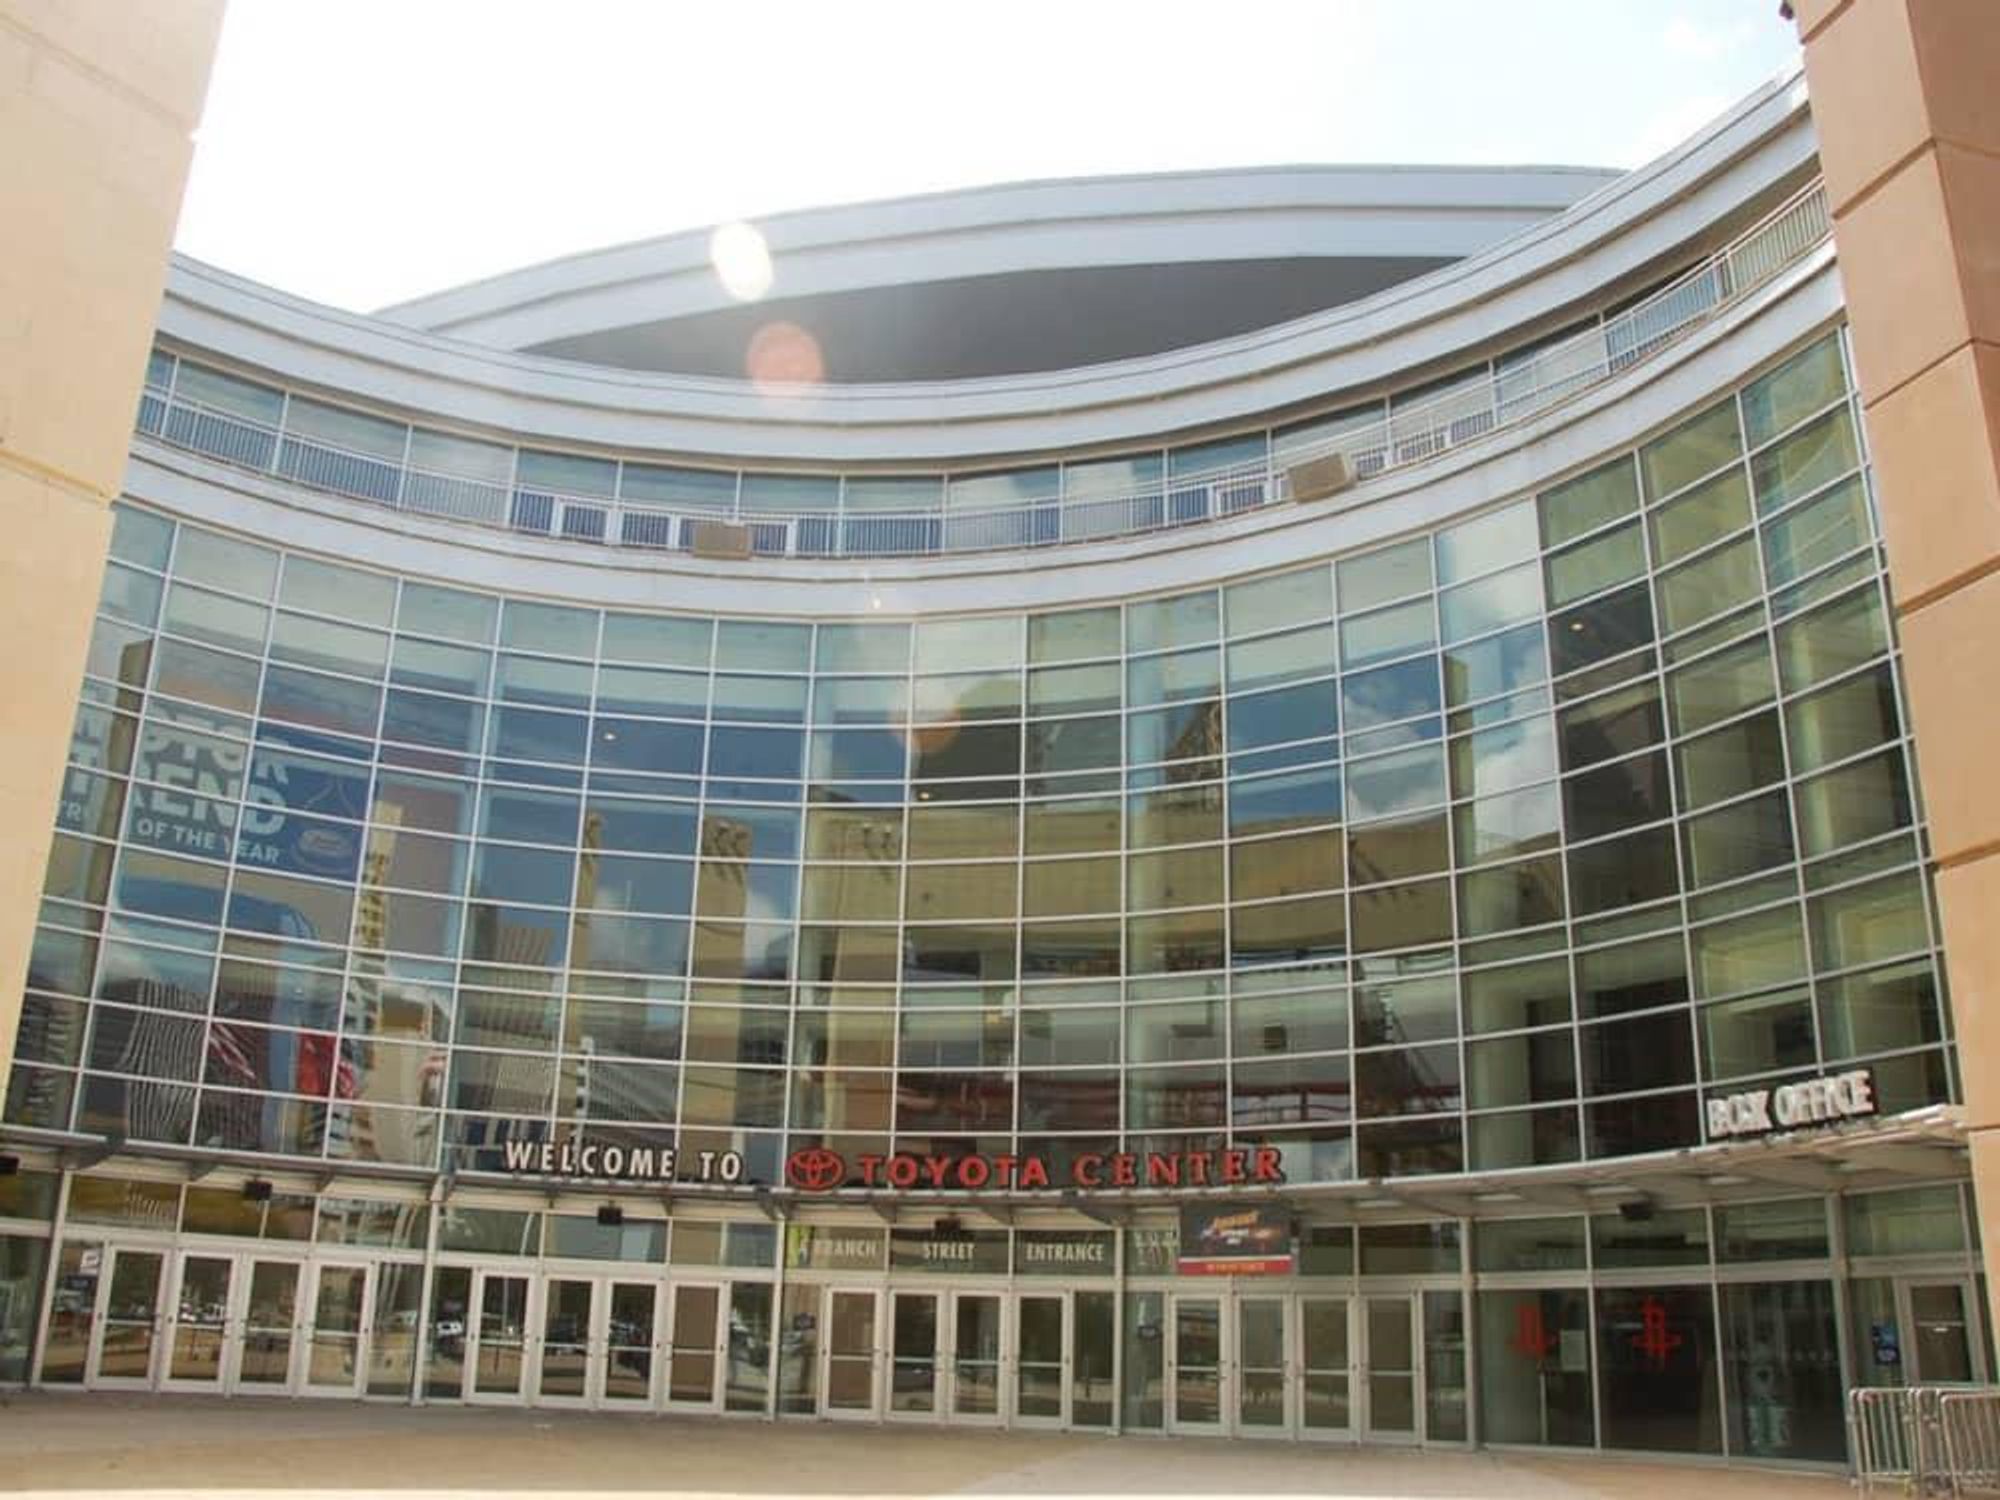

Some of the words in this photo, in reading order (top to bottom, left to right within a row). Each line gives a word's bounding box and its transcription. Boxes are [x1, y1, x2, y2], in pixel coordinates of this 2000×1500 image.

[136, 817, 168, 840] OF
[172, 824, 217, 851] THE
[223, 833, 281, 864] YEAR
[1706, 1090, 1773, 1137] BOX
[1775, 1069, 1874, 1126] OFFICE
[506, 1141, 674, 1178] WELCOME
[700, 1151, 741, 1181] TO
[857, 1153, 1049, 1187] TOYOTA
[1072, 1147, 1282, 1187] CENTER
[923, 1241, 975, 1260] STREET
[1026, 1242, 1104, 1262] ENTRANCE
